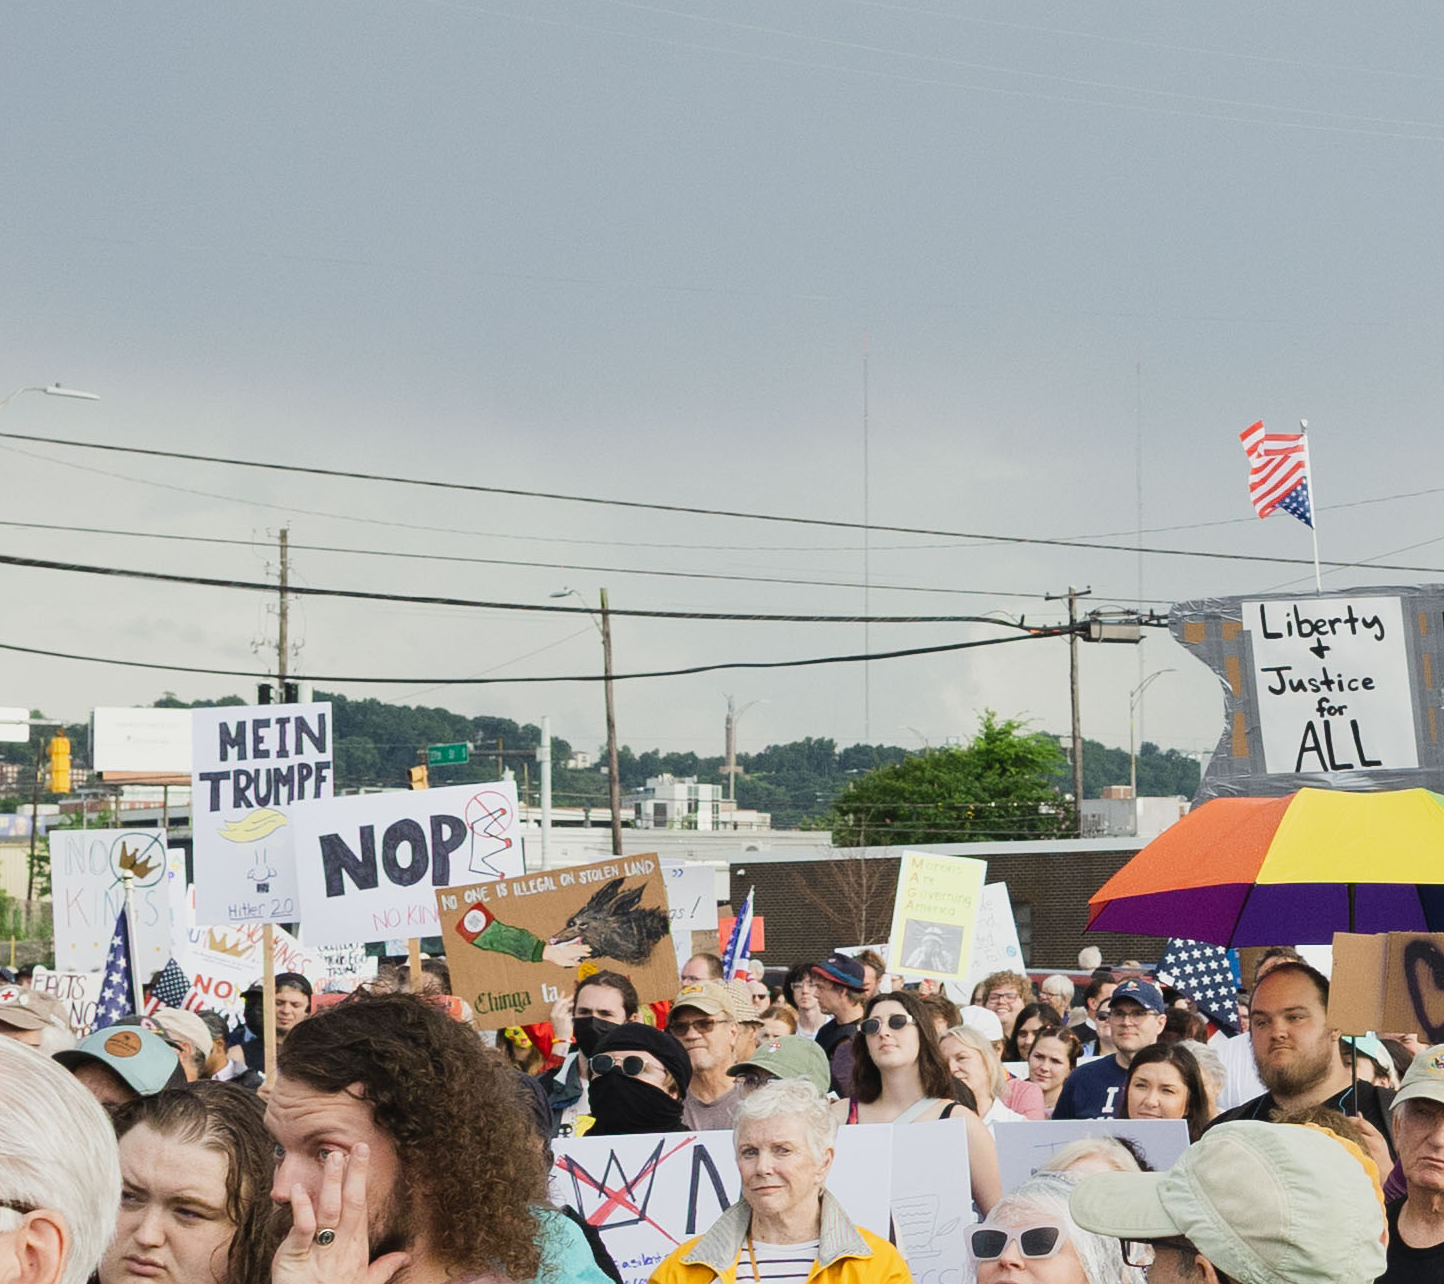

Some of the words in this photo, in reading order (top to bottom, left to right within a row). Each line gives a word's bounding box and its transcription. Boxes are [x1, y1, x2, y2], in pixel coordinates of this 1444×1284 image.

[1260, 604, 1385, 641] Liberty
[1261, 666, 1375, 695] Justice
[1316, 697, 1348, 717] for
[219, 713, 326, 761] MEIN
[1295, 720, 1382, 773] ALL
[199, 761, 331, 812] TRUMPF
[66, 835, 107, 876] NO
[441, 894, 458, 910] NO
[464, 887, 491, 904] ONE
[496, 883, 509, 898] IS
[513, 877, 557, 897] ILLEGAL
[560, 871, 576, 886] ON
[579, 865, 620, 884] STOLEN
[624, 859, 655, 877] LAND
[66, 887, 159, 927] KINS
[228, 901, 265, 918] Hitler
[372, 908, 401, 931] NO
[33, 973, 87, 1000] FACTS
[194, 974, 232, 999] NO
[474, 989, 532, 1014] Chinga
